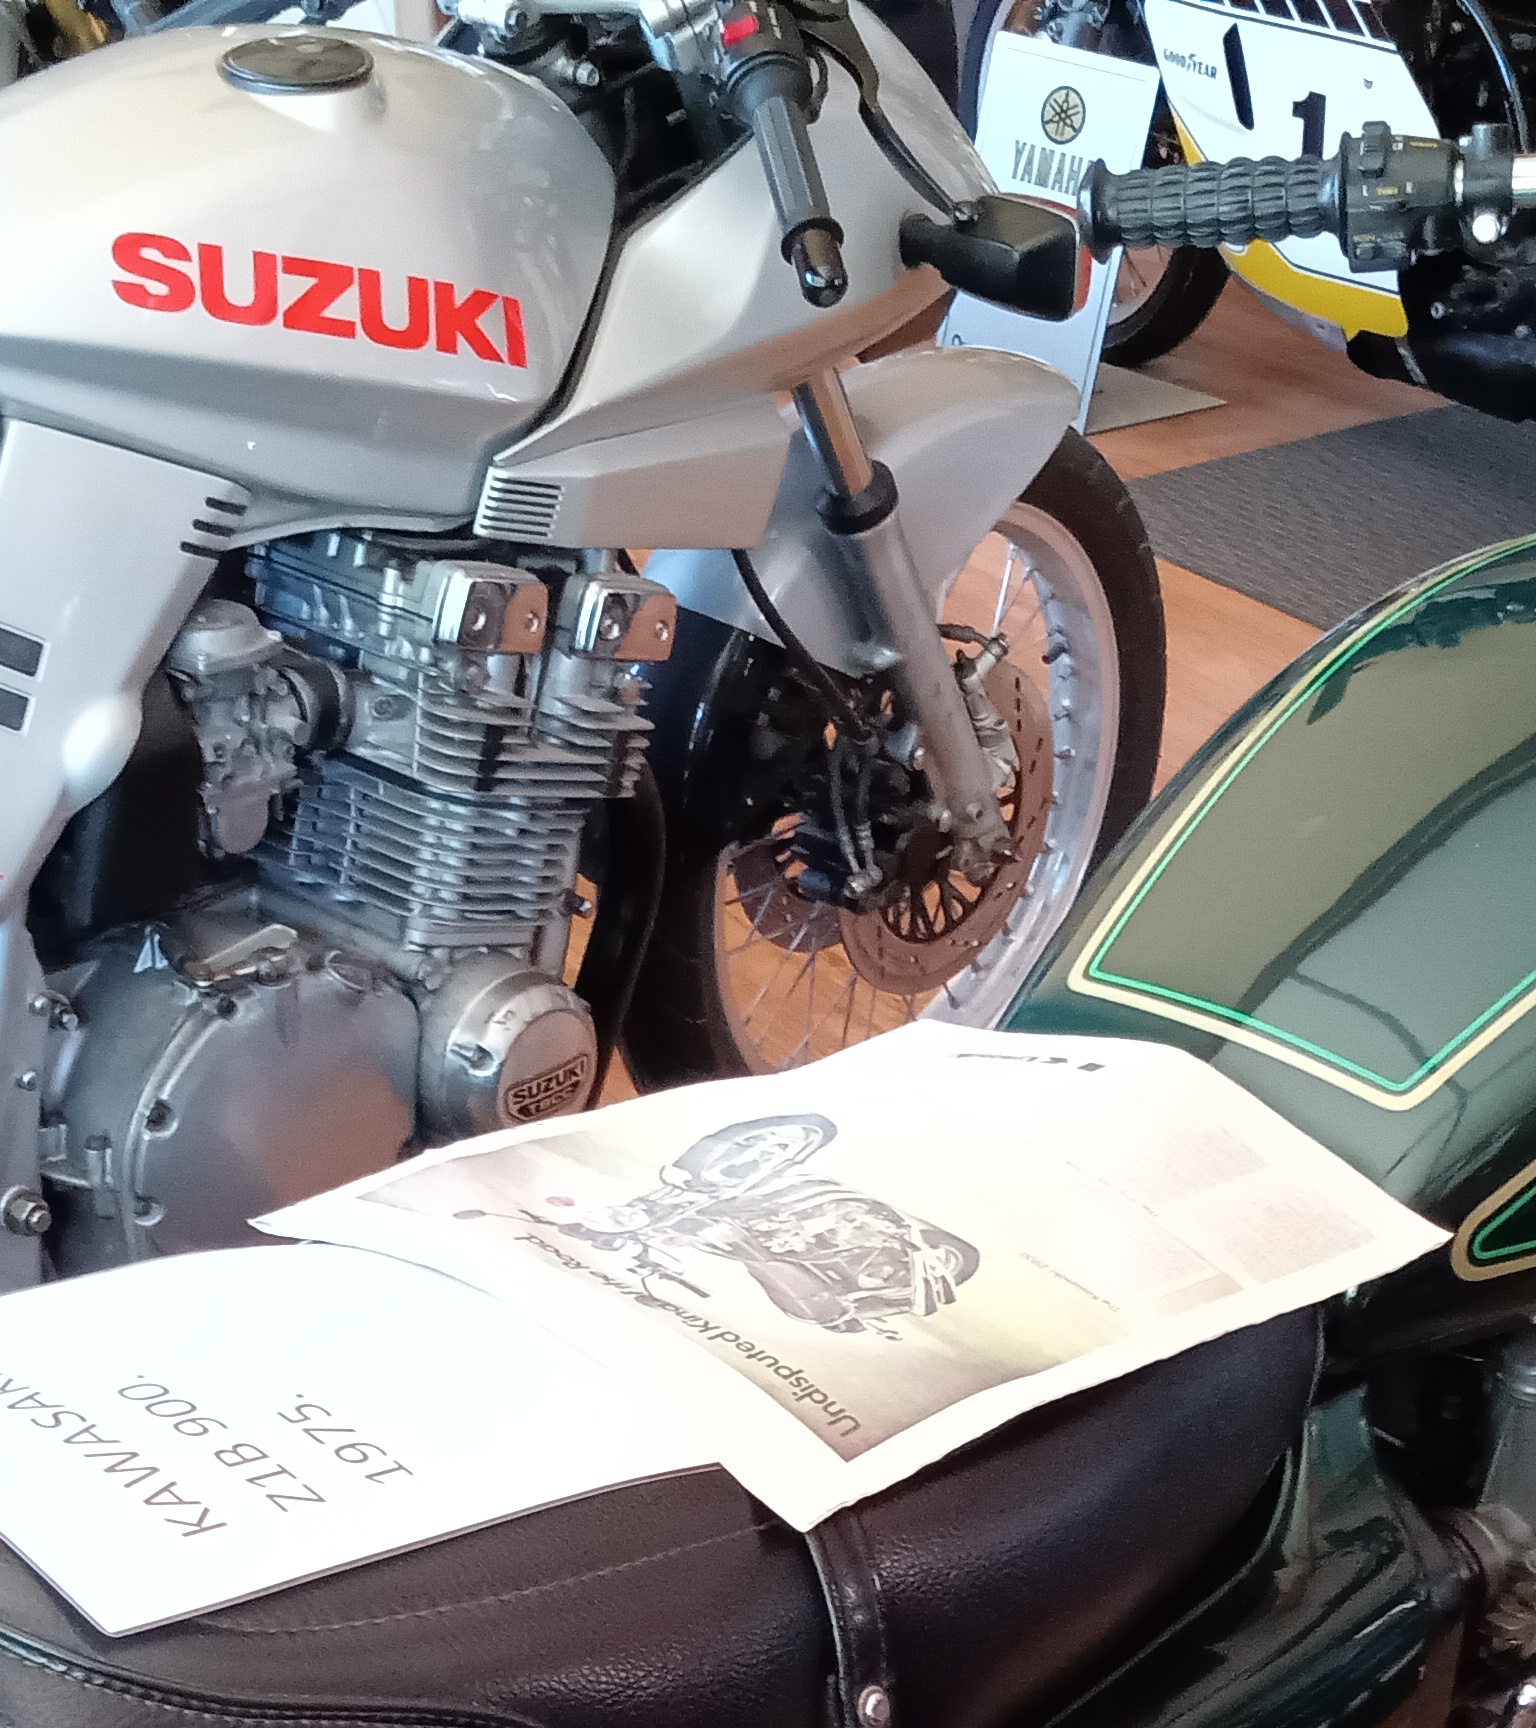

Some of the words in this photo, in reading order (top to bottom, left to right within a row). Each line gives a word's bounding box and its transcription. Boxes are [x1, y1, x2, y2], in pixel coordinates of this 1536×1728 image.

[1163, 48, 1218, 80] GOODYEAR
[1011, 139, 1090, 197] YAMAH
[111, 231, 529, 370] SUZUKI
[511, 1059, 585, 1106] SUZUKI
[513, 1232, 590, 1271] Road
[117, 1374, 229, 1437] 900.
[706, 1329, 862, 1438] Undisputed
[276, 1393, 415, 1485] 1975.
[213, 1443, 327, 1512] Z1B
